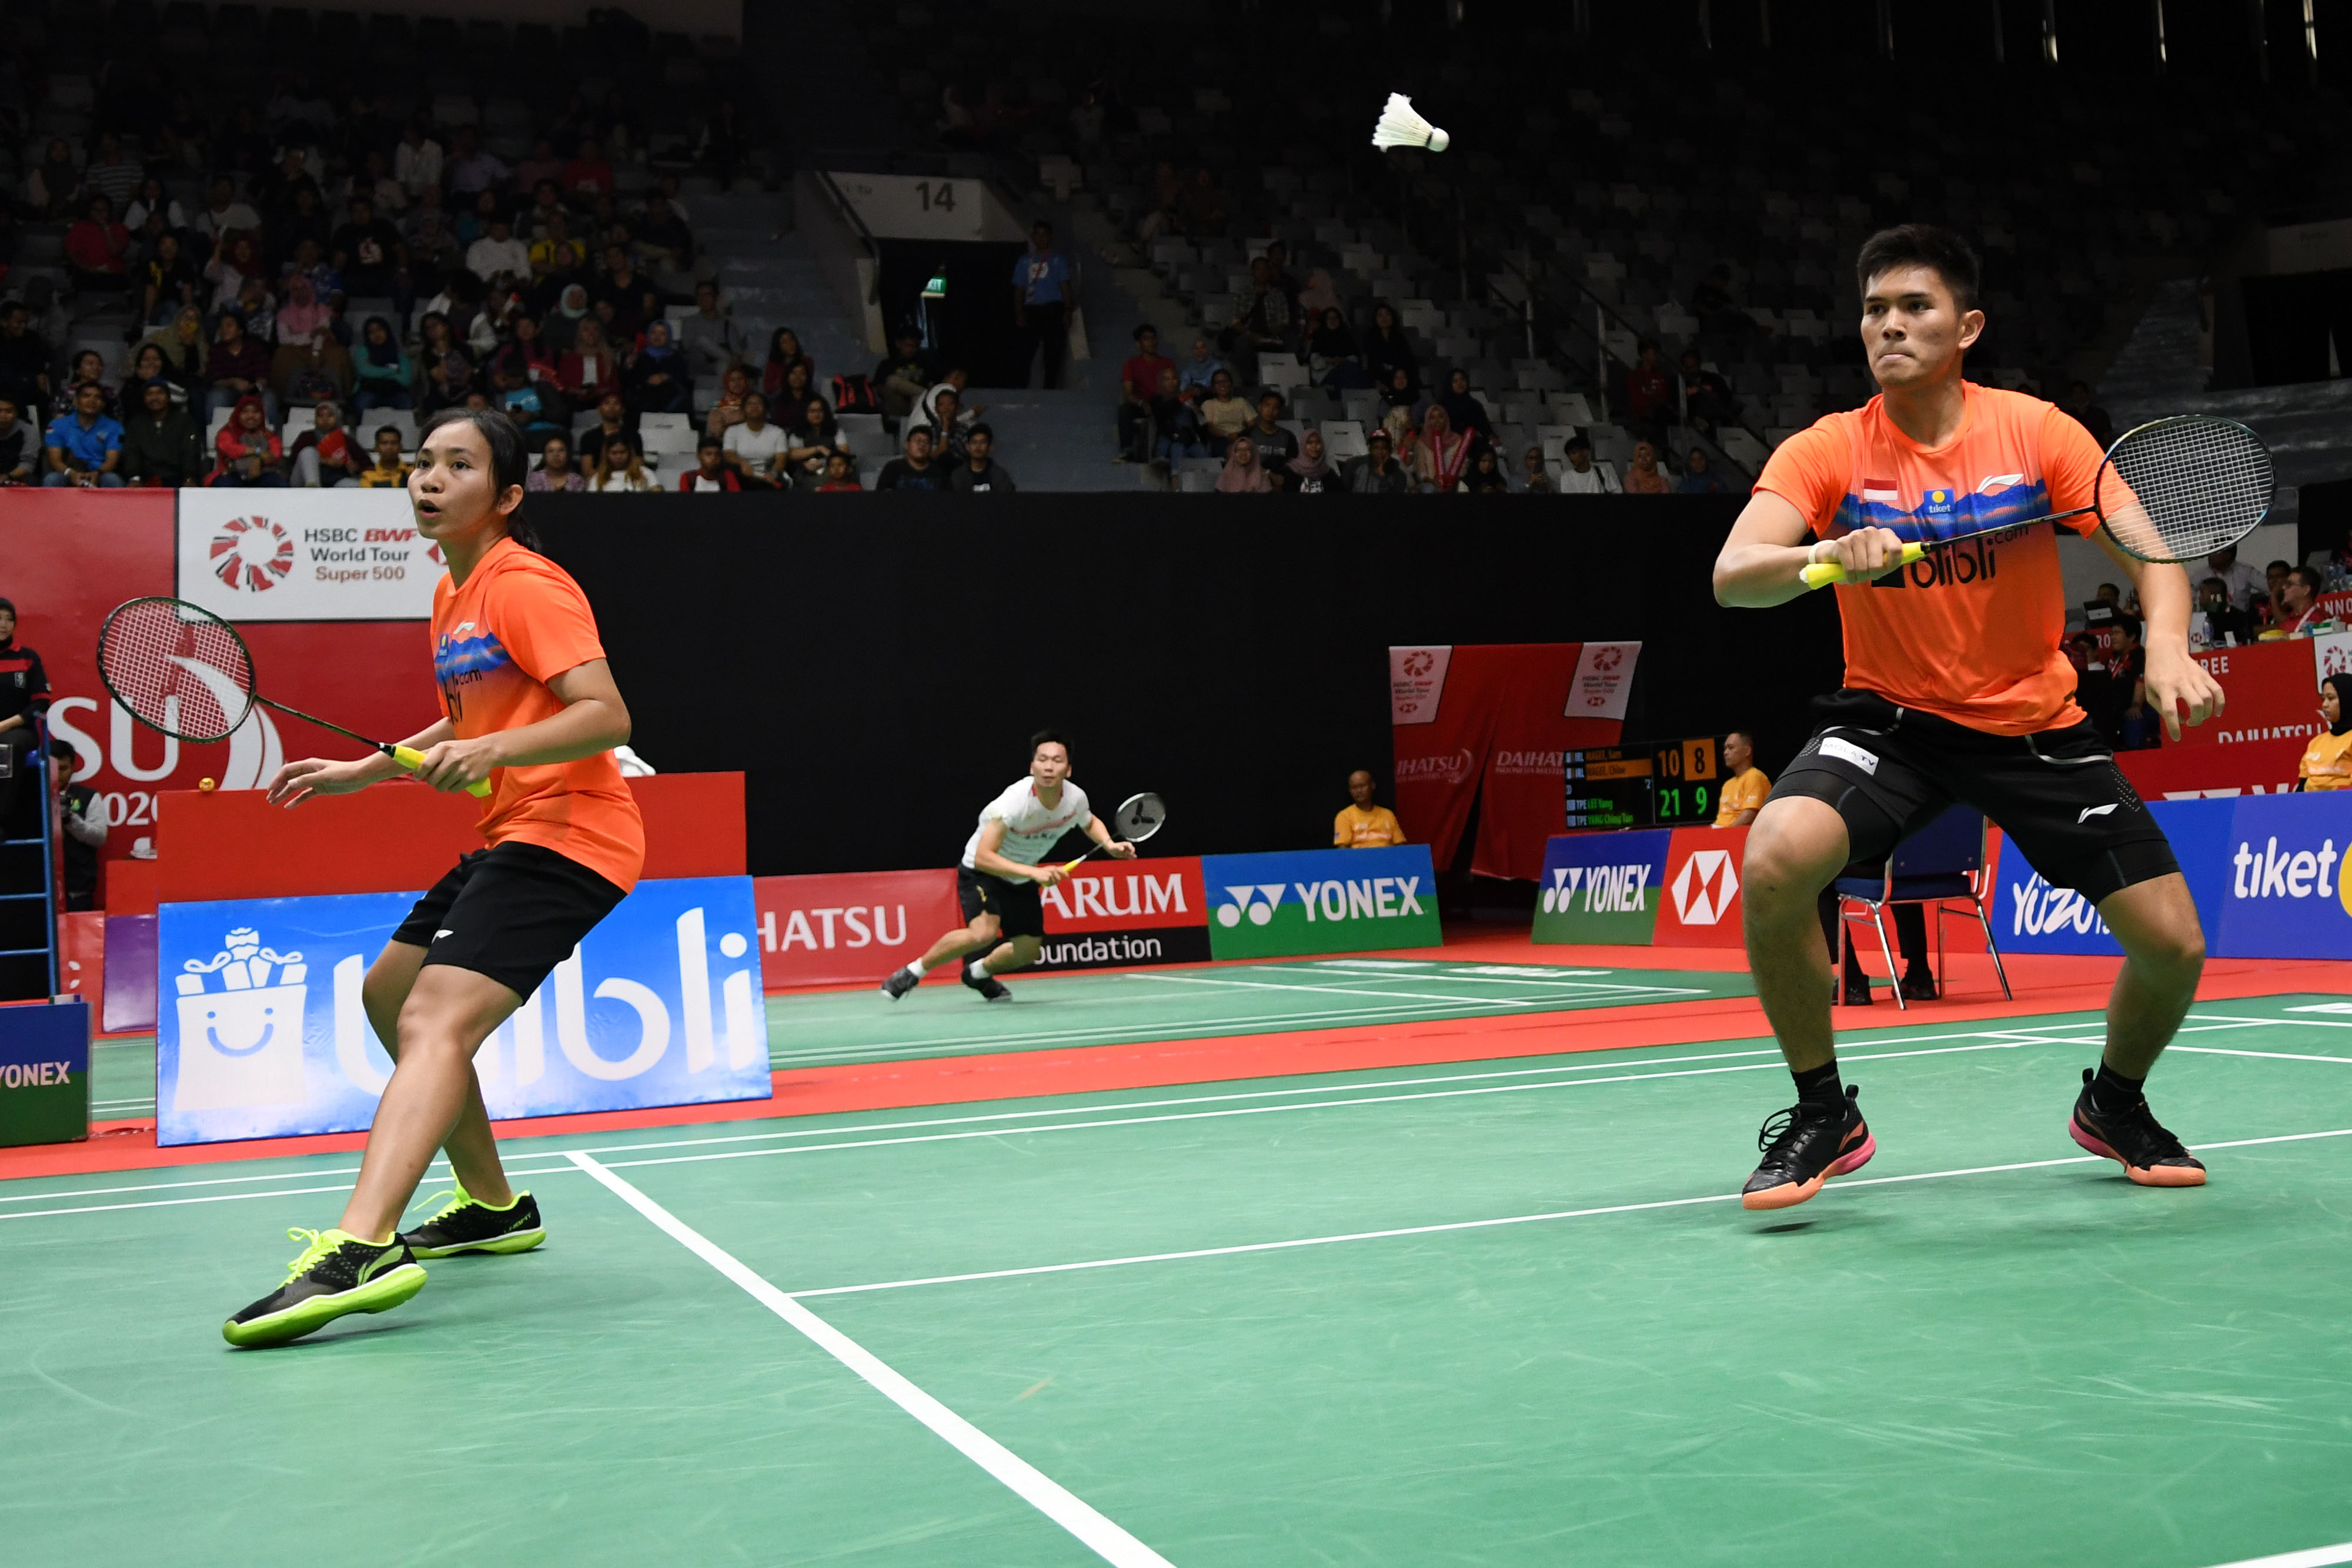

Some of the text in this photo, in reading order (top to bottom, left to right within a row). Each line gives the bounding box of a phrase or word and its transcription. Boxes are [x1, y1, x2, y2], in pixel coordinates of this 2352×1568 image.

[915, 182, 957, 212] 14
[1929, 504, 1951, 513] tiket
[305, 529, 418, 542] HSBC BWF
[310, 547, 409, 561] World Tour
[316, 566, 405, 582] Super 500
[1658, 747, 1705, 778] 10 8
[1659, 786, 1708, 817] 21 9
[2234, 837, 2337, 898] tiket
[1295, 876, 1424, 922] YONEX
[1585, 864, 1652, 912] YONEX
